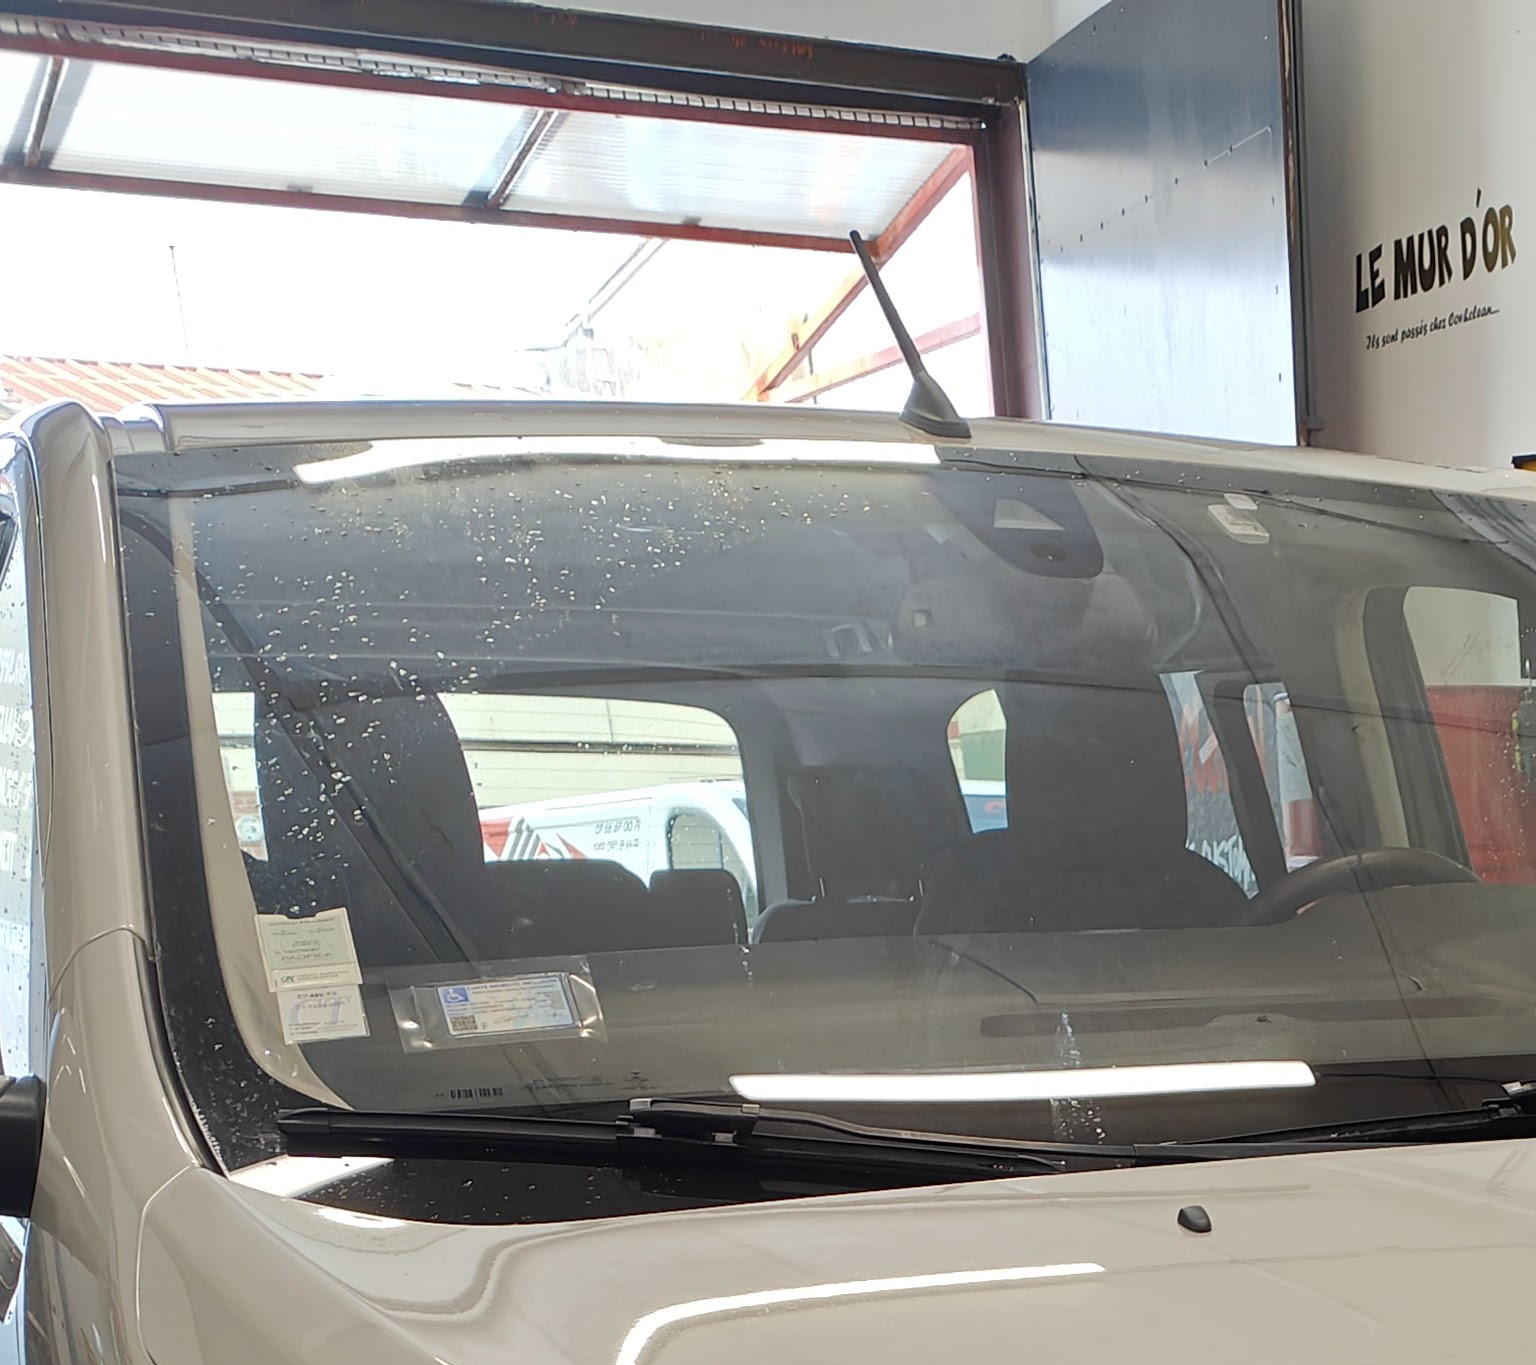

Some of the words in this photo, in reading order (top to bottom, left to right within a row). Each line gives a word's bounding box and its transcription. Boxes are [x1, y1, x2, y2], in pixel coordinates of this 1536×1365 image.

[1355, 244, 1386, 314] LE
[1393, 224, 1454, 302] MUR
[1459, 187, 1517, 282] D'OR
[1365, 334, 1380, 350] Ils
[1381, 328, 1399, 348] sont
[1429, 316, 1447, 333] chez
